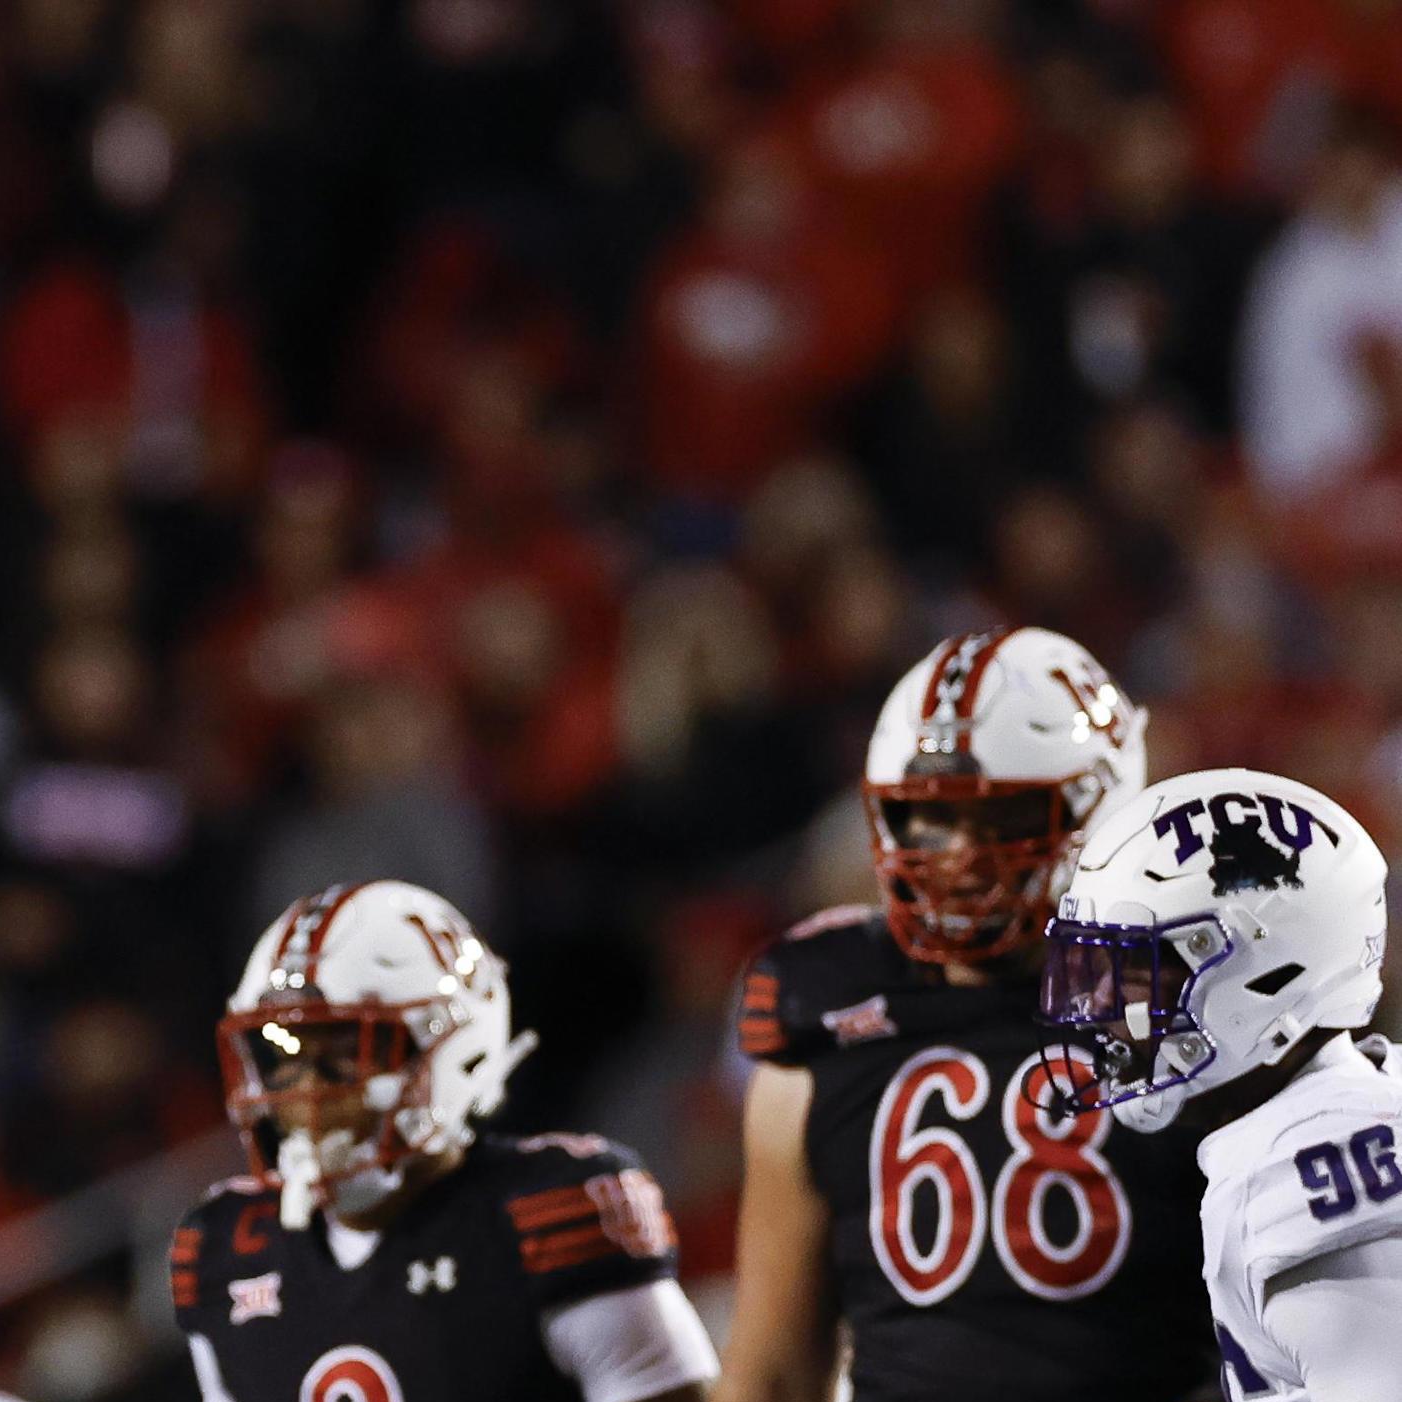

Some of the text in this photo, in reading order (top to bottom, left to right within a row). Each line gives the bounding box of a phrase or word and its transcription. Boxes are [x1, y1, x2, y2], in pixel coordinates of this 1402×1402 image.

[1153, 793, 1313, 866] TCU
[870, 1044, 1132, 1306] 68
[1294, 1124, 1402, 1223] 96
